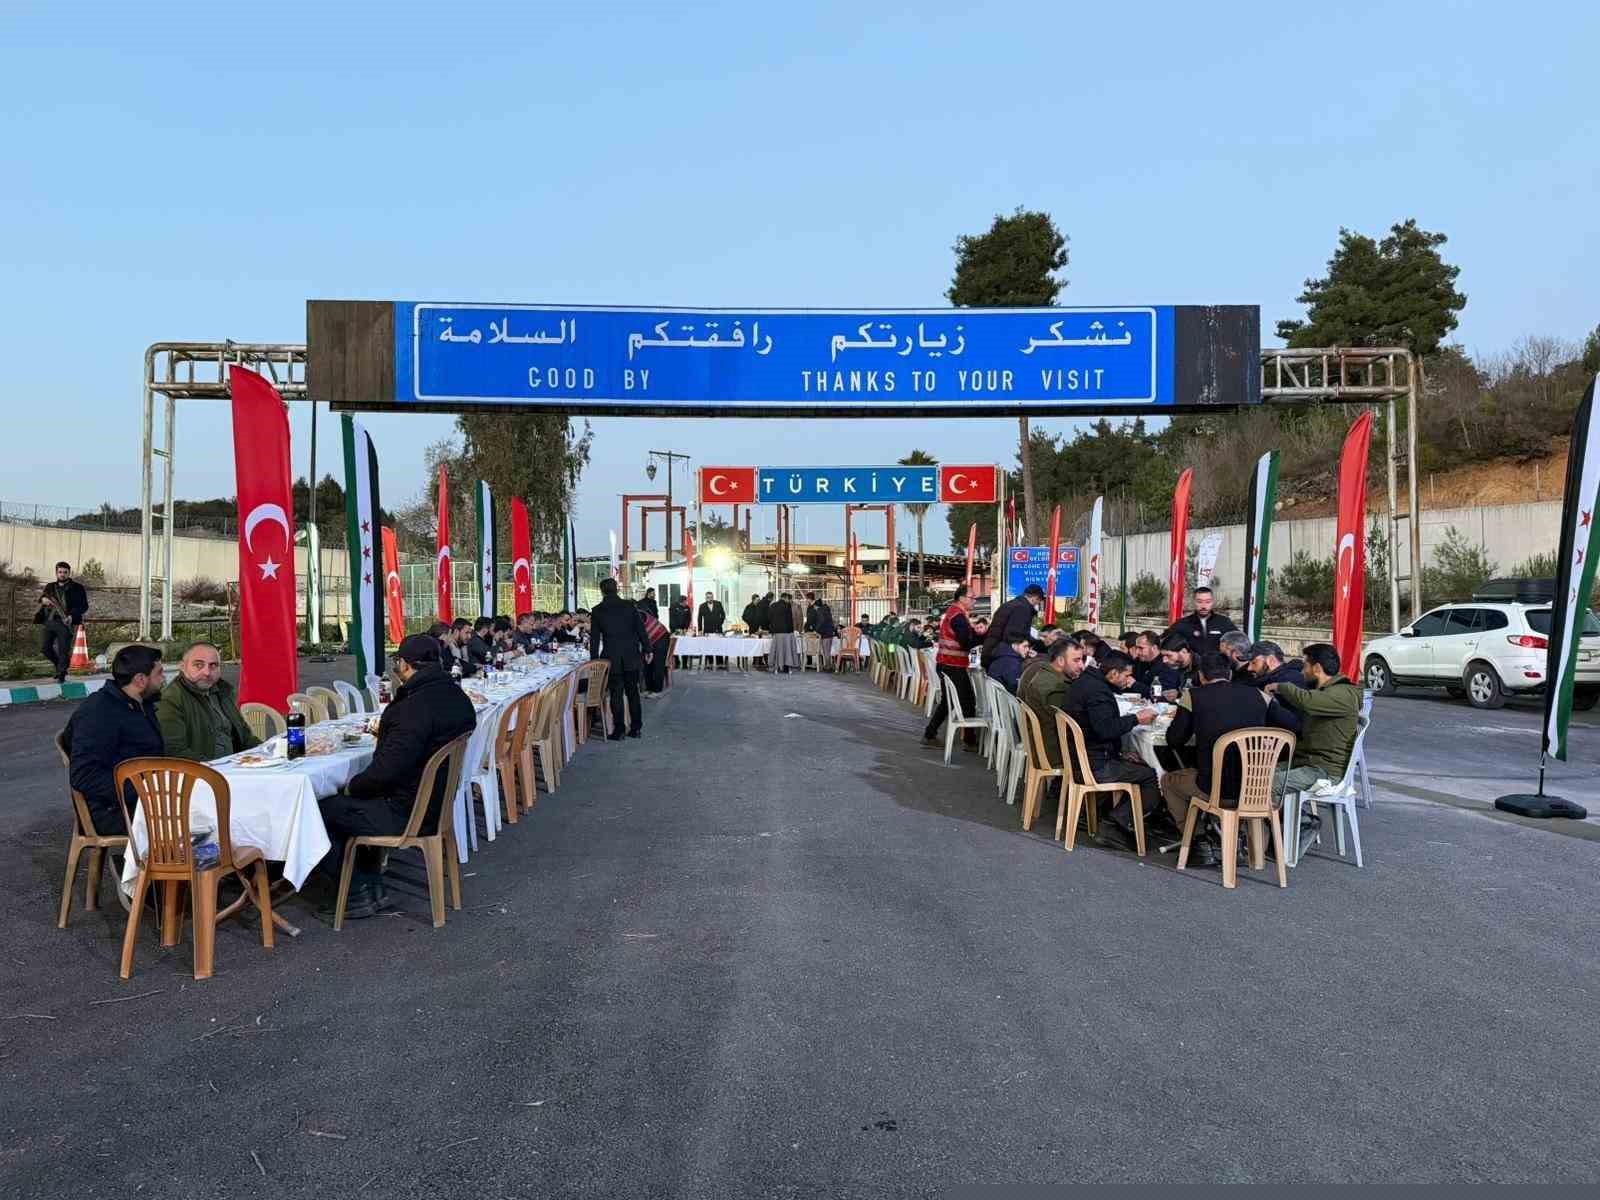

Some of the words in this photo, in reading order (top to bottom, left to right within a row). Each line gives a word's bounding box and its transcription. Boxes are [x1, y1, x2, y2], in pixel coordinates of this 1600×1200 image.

[439, 317, 576, 344] السلامة
[629, 321, 772, 359] رافقتكم
[832, 323, 965, 361] زيارتكم
[1023, 321, 1132, 354] نشكر
[528, 367, 594, 389] GOOD
[624, 370, 649, 390] BY
[802, 371, 895, 392] THANKS
[911, 371, 936, 391] TO
[959, 370, 1013, 391] YOUR
[1041, 369, 1104, 390] VISIT
[763, 472, 933, 493] TÜRKİYE
